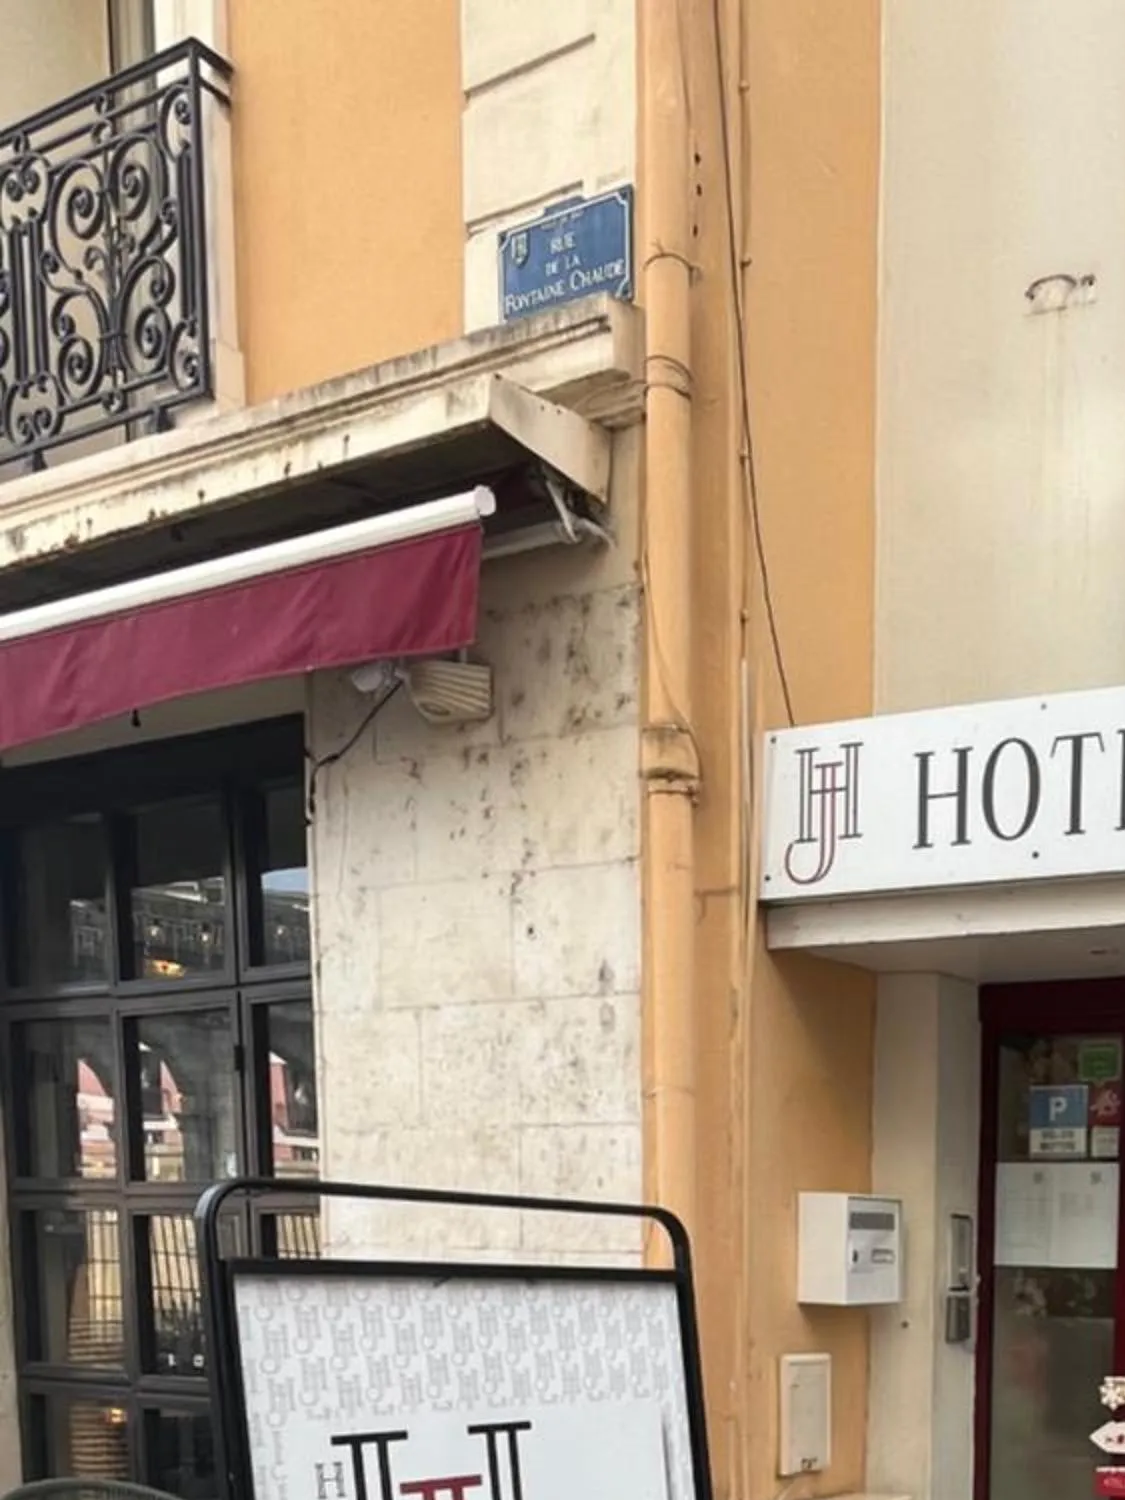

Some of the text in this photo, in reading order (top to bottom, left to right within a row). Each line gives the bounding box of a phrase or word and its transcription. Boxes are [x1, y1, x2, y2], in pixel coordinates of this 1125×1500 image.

[550, 231, 576, 254] RUE
[545, 254, 581, 277] DE LA
[504, 258, 625, 315] FONTAINE CHAUDE
[1048, 1096, 1068, 1121] P
